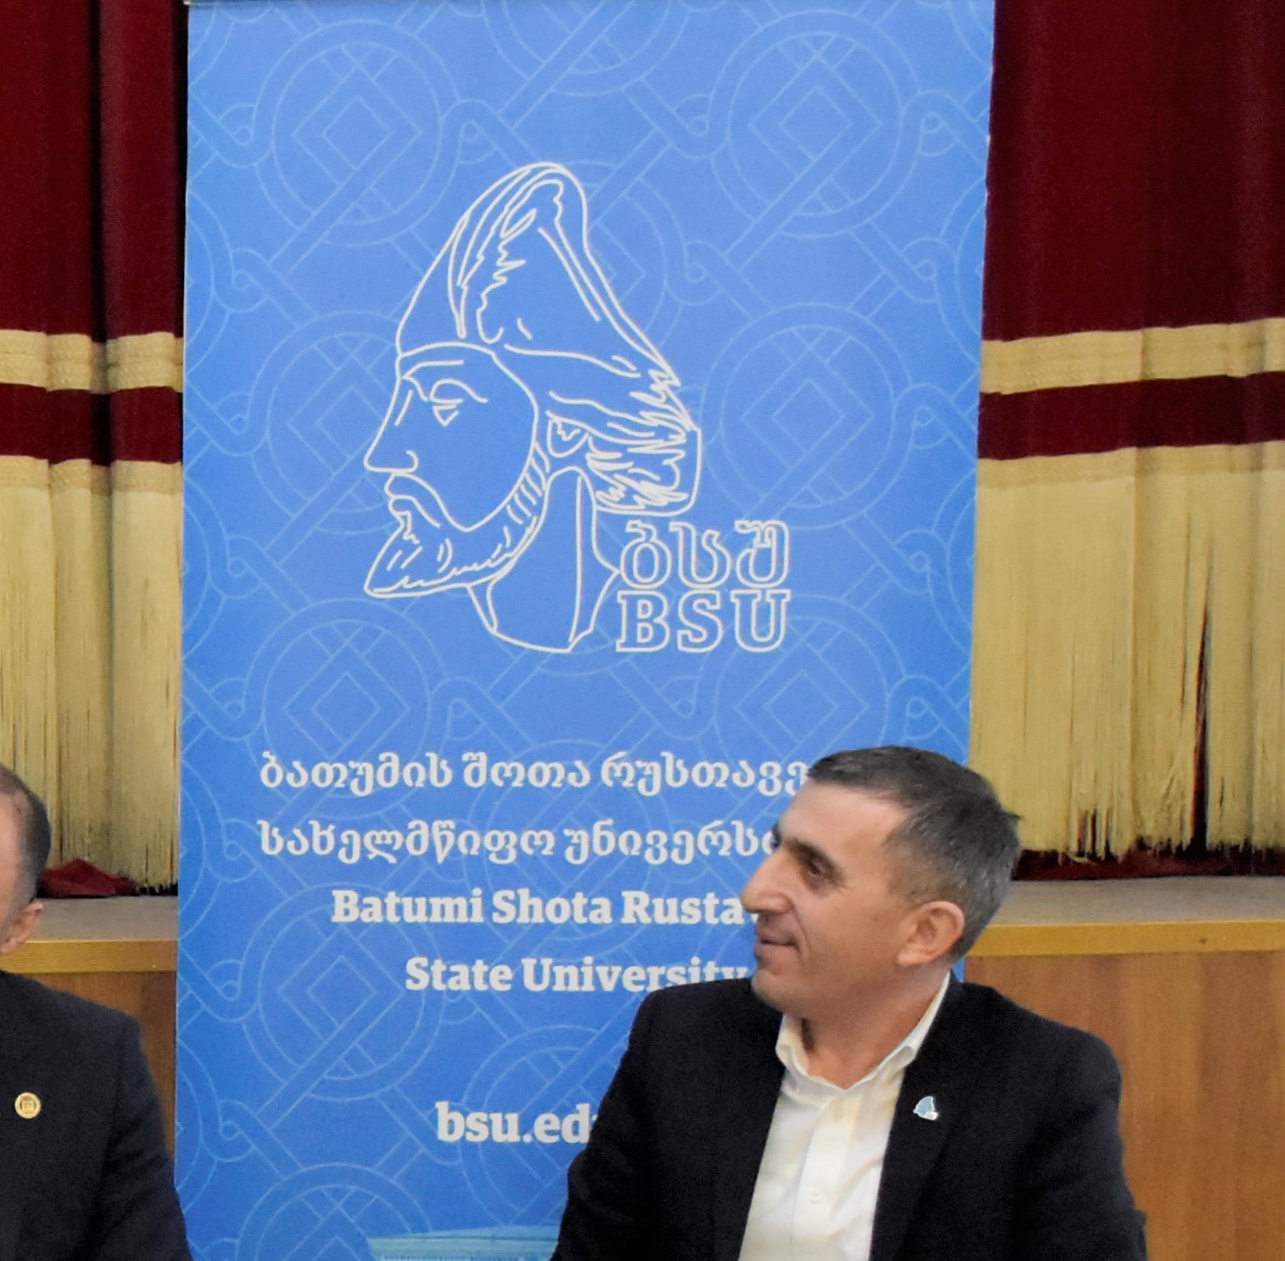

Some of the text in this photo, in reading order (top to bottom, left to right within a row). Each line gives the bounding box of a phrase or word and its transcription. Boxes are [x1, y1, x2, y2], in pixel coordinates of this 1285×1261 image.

[615, 589, 792, 653] BSU
[259, 751, 810, 797] ბათუმის შოთა რუსთავე
[256, 818, 774, 866] სახელმწიფო უნივერს
[332, 887, 748, 926] Batumi Shota Rusta
[405, 956, 513, 992] State
[435, 1100, 594, 1144] bsu.ed
